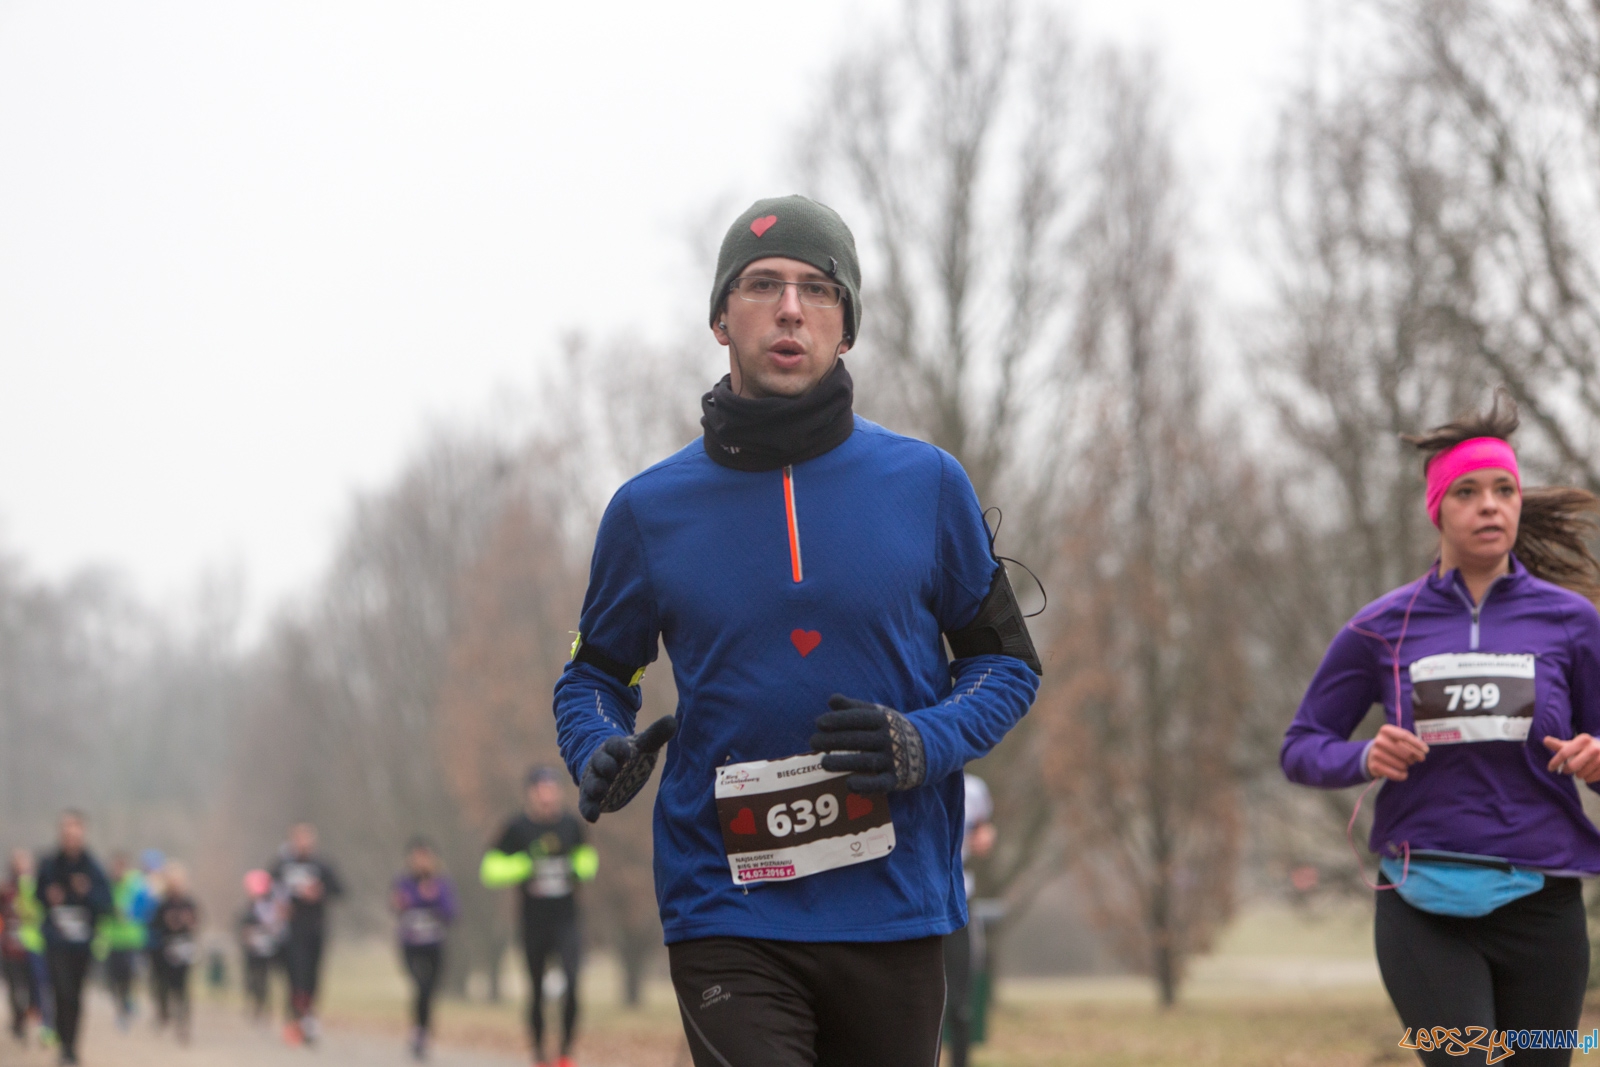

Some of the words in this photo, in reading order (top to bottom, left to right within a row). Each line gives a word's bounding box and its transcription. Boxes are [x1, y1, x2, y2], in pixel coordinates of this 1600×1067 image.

[1444, 683, 1500, 711] 799
[767, 793, 839, 837] 639
[760, 859, 793, 867] POZNANIU
[740, 867, 785, 880] 14.02.2016
[786, 868, 795, 876] r.
